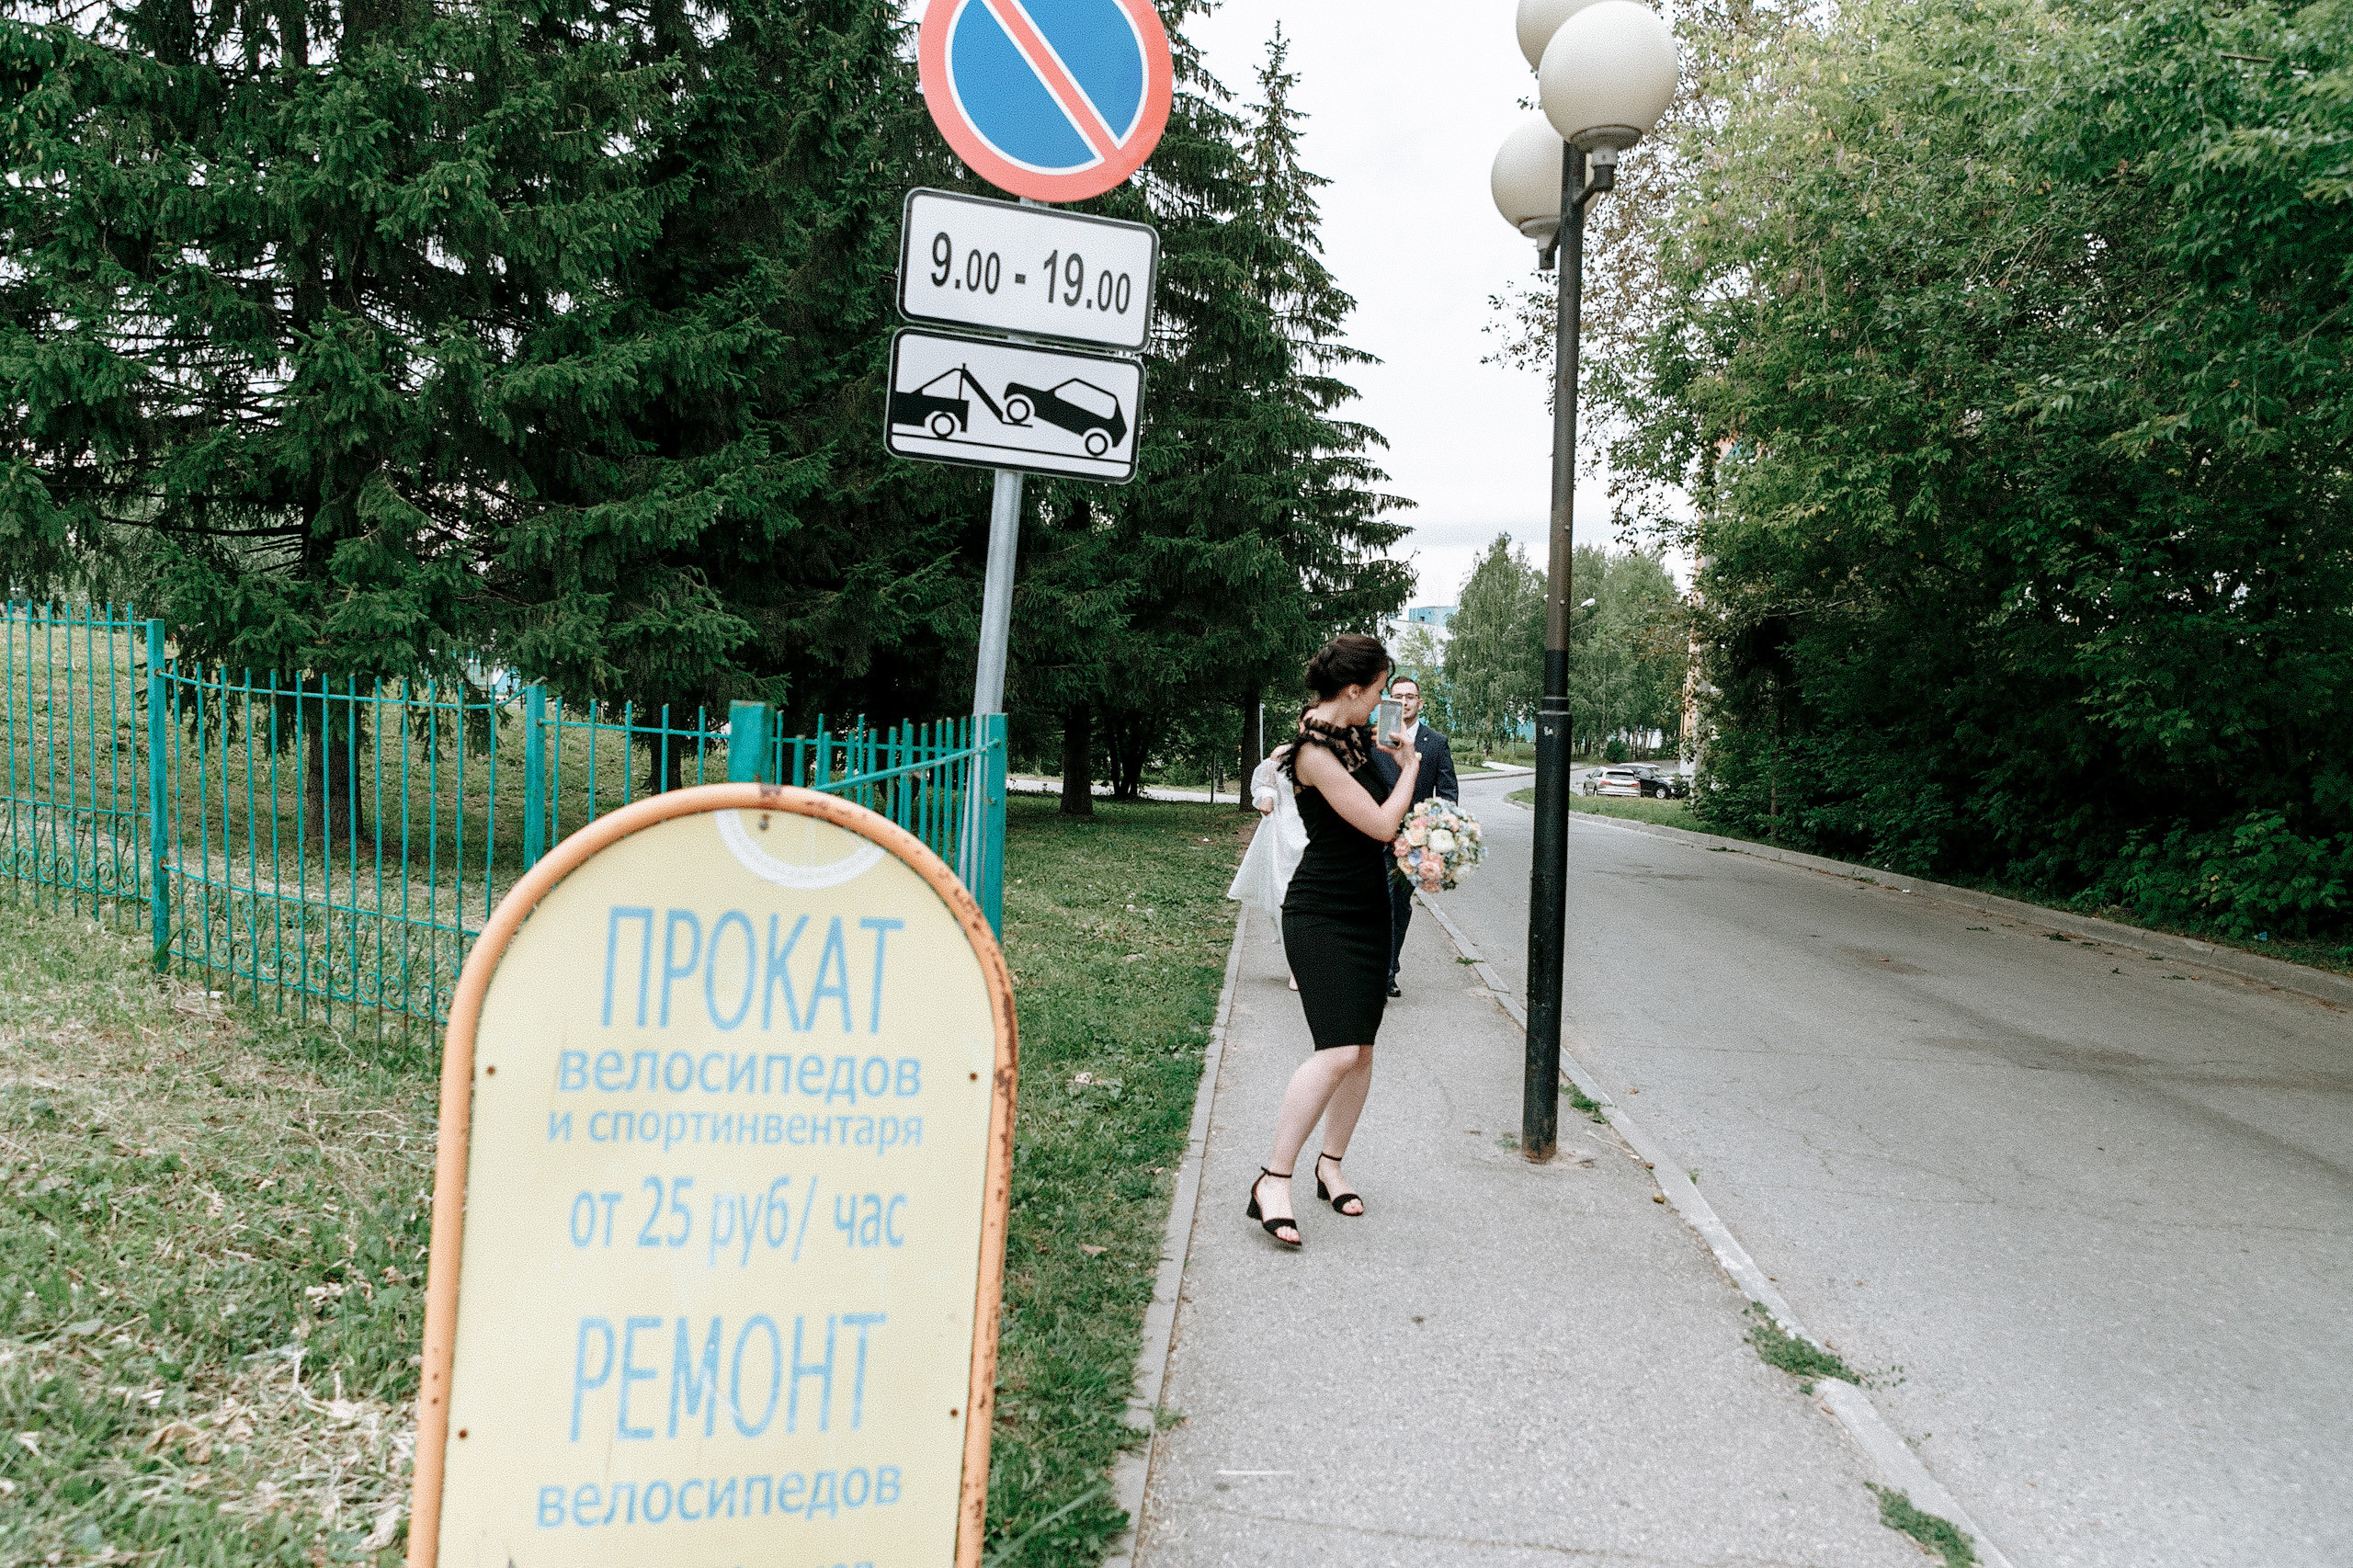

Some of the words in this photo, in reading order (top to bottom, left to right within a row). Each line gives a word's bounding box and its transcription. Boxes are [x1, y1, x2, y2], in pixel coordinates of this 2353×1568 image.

[930, 232, 1001, 294] 9.00
[1042, 249, 1131, 314] 19.00
[599, 906, 904, 1034] ПРОКАТ
[557, 1049, 921, 1104] велосипедов
[547, 1112, 572, 1142] и
[588, 1110, 922, 1155] спортинвентаря
[569, 1191, 623, 1249] от
[637, 1176, 695, 1249] 25
[833, 1193, 907, 1248] час
[569, 1312, 888, 1443] РЕМОНТ
[536, 1465, 903, 1529] велосипедов
